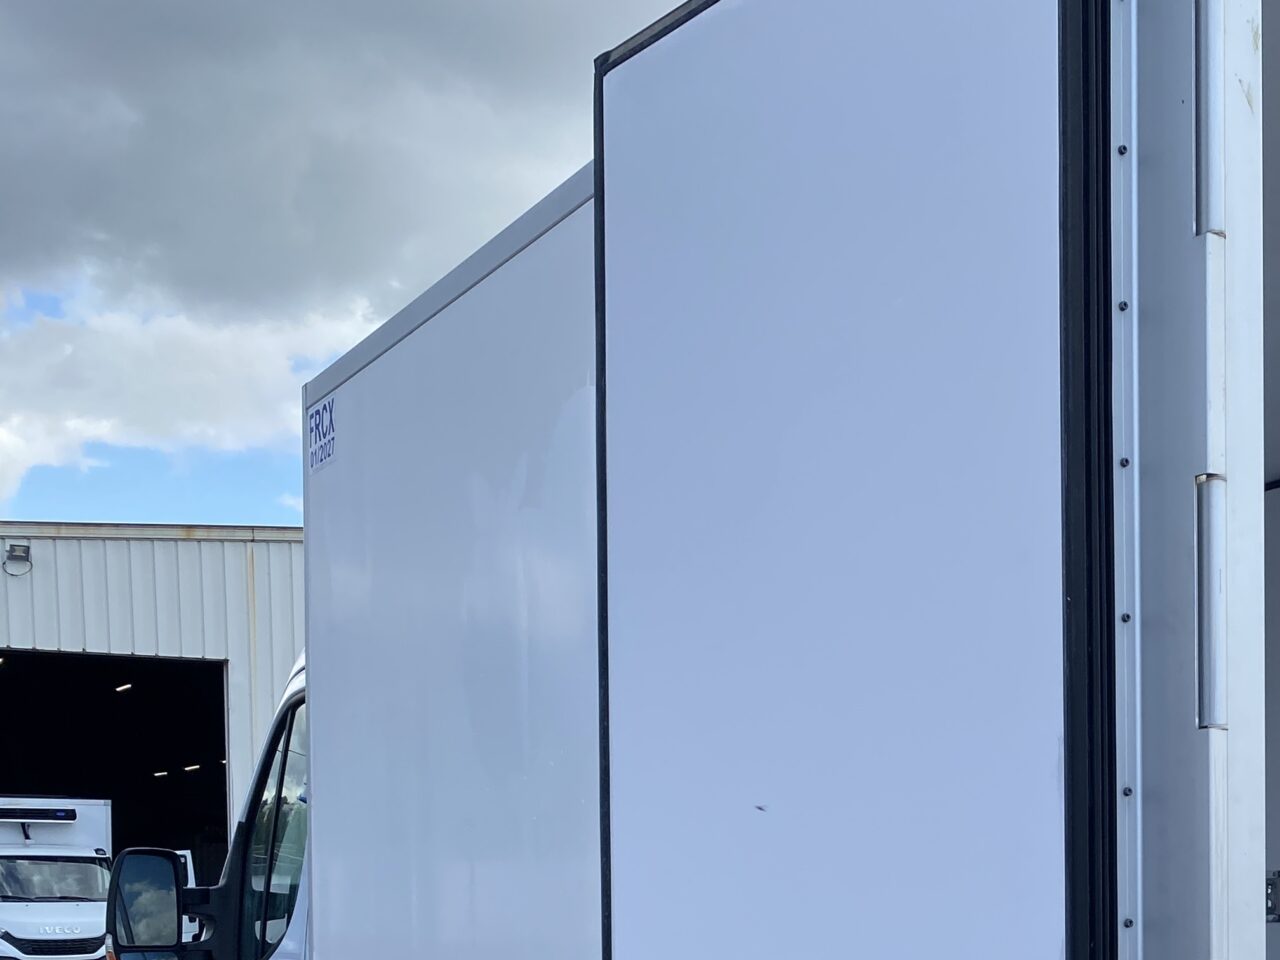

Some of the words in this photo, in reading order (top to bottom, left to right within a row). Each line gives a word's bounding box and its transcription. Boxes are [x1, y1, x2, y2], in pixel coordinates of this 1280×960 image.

[309, 398, 335, 448] FRCX
[310, 436, 335, 468] 01/2027
[39, 926, 81, 934] IVECO
